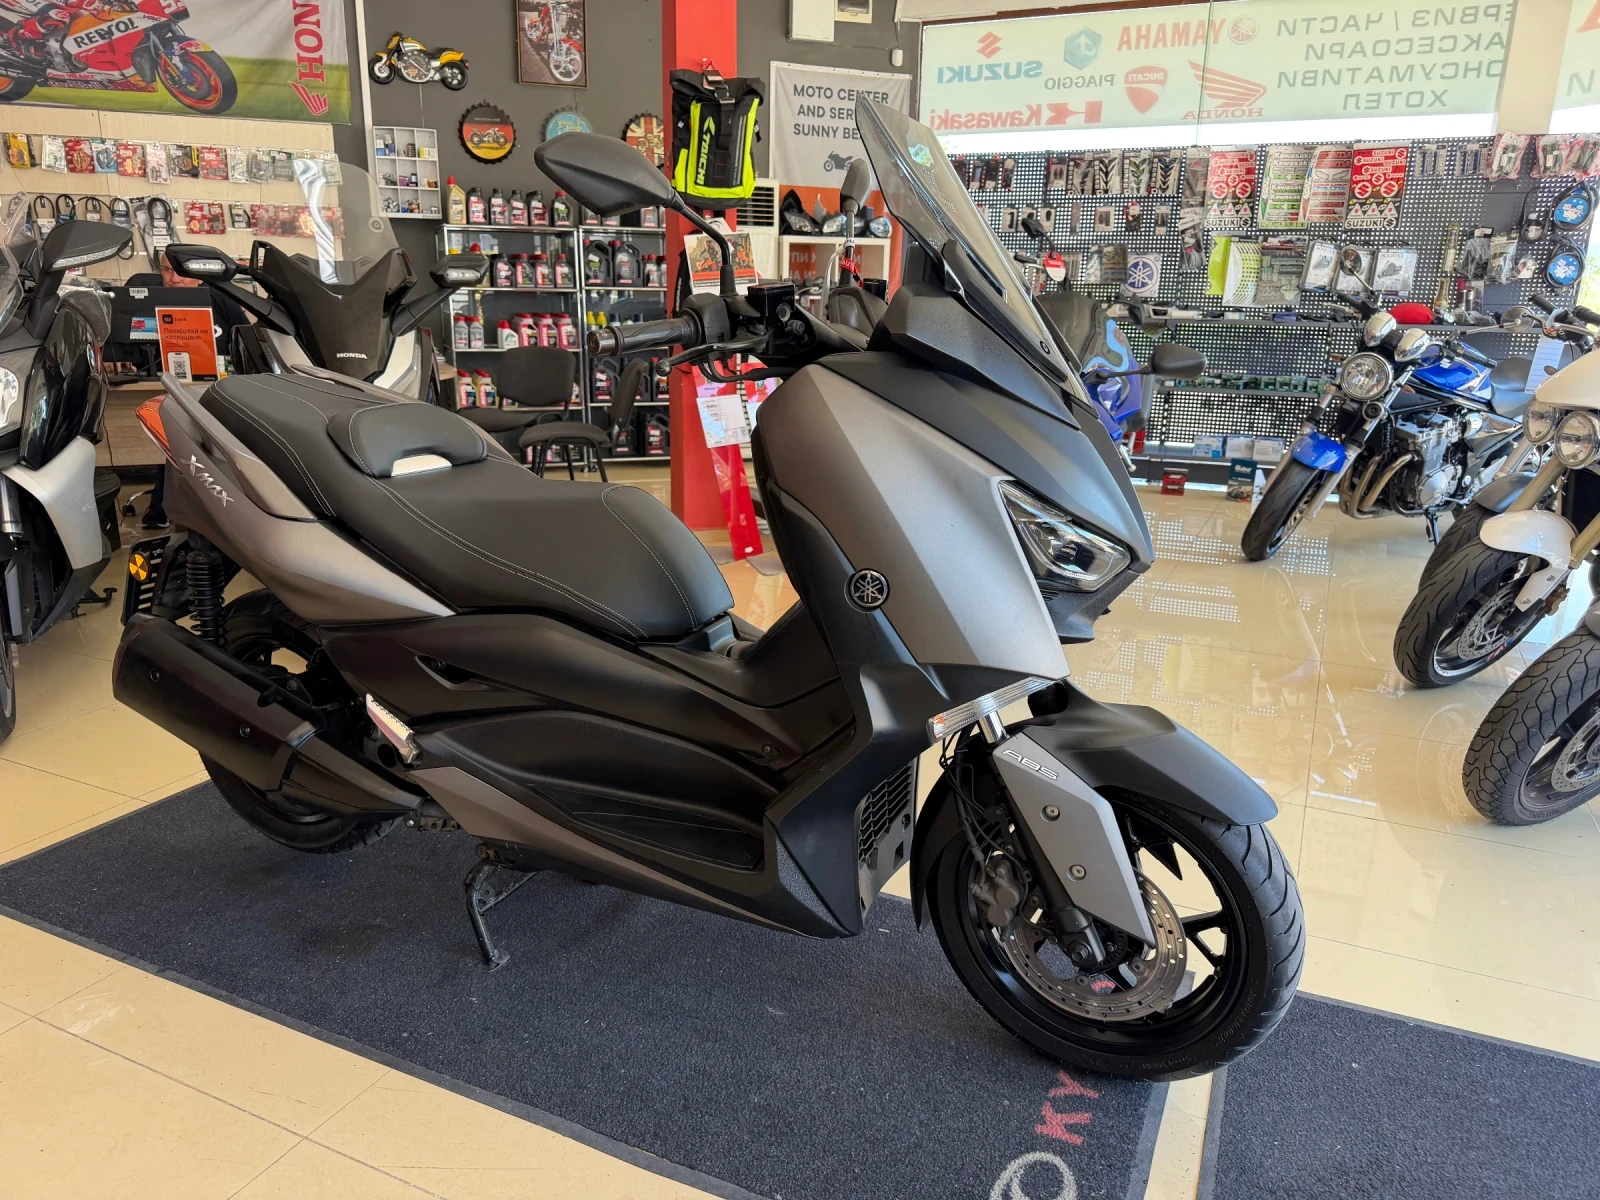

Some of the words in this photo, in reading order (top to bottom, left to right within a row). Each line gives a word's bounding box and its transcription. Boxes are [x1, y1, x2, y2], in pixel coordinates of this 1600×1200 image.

[292, 0, 325, 82] HON
[793, 84, 833, 99] MOTO
[797, 104, 825, 117] AND
[829, 107, 853, 120] SER
[793, 123, 839, 138] SUNNY
[843, 127, 861, 140] BE
[1274, 151, 1312, 159] Kawasaki
[1346, 220, 1382, 228] SUZUKI
[163, 327, 199, 335] Пазарувай
[1002, 749, 1058, 780] ABS
[1034, 1069, 1099, 1146] KY
